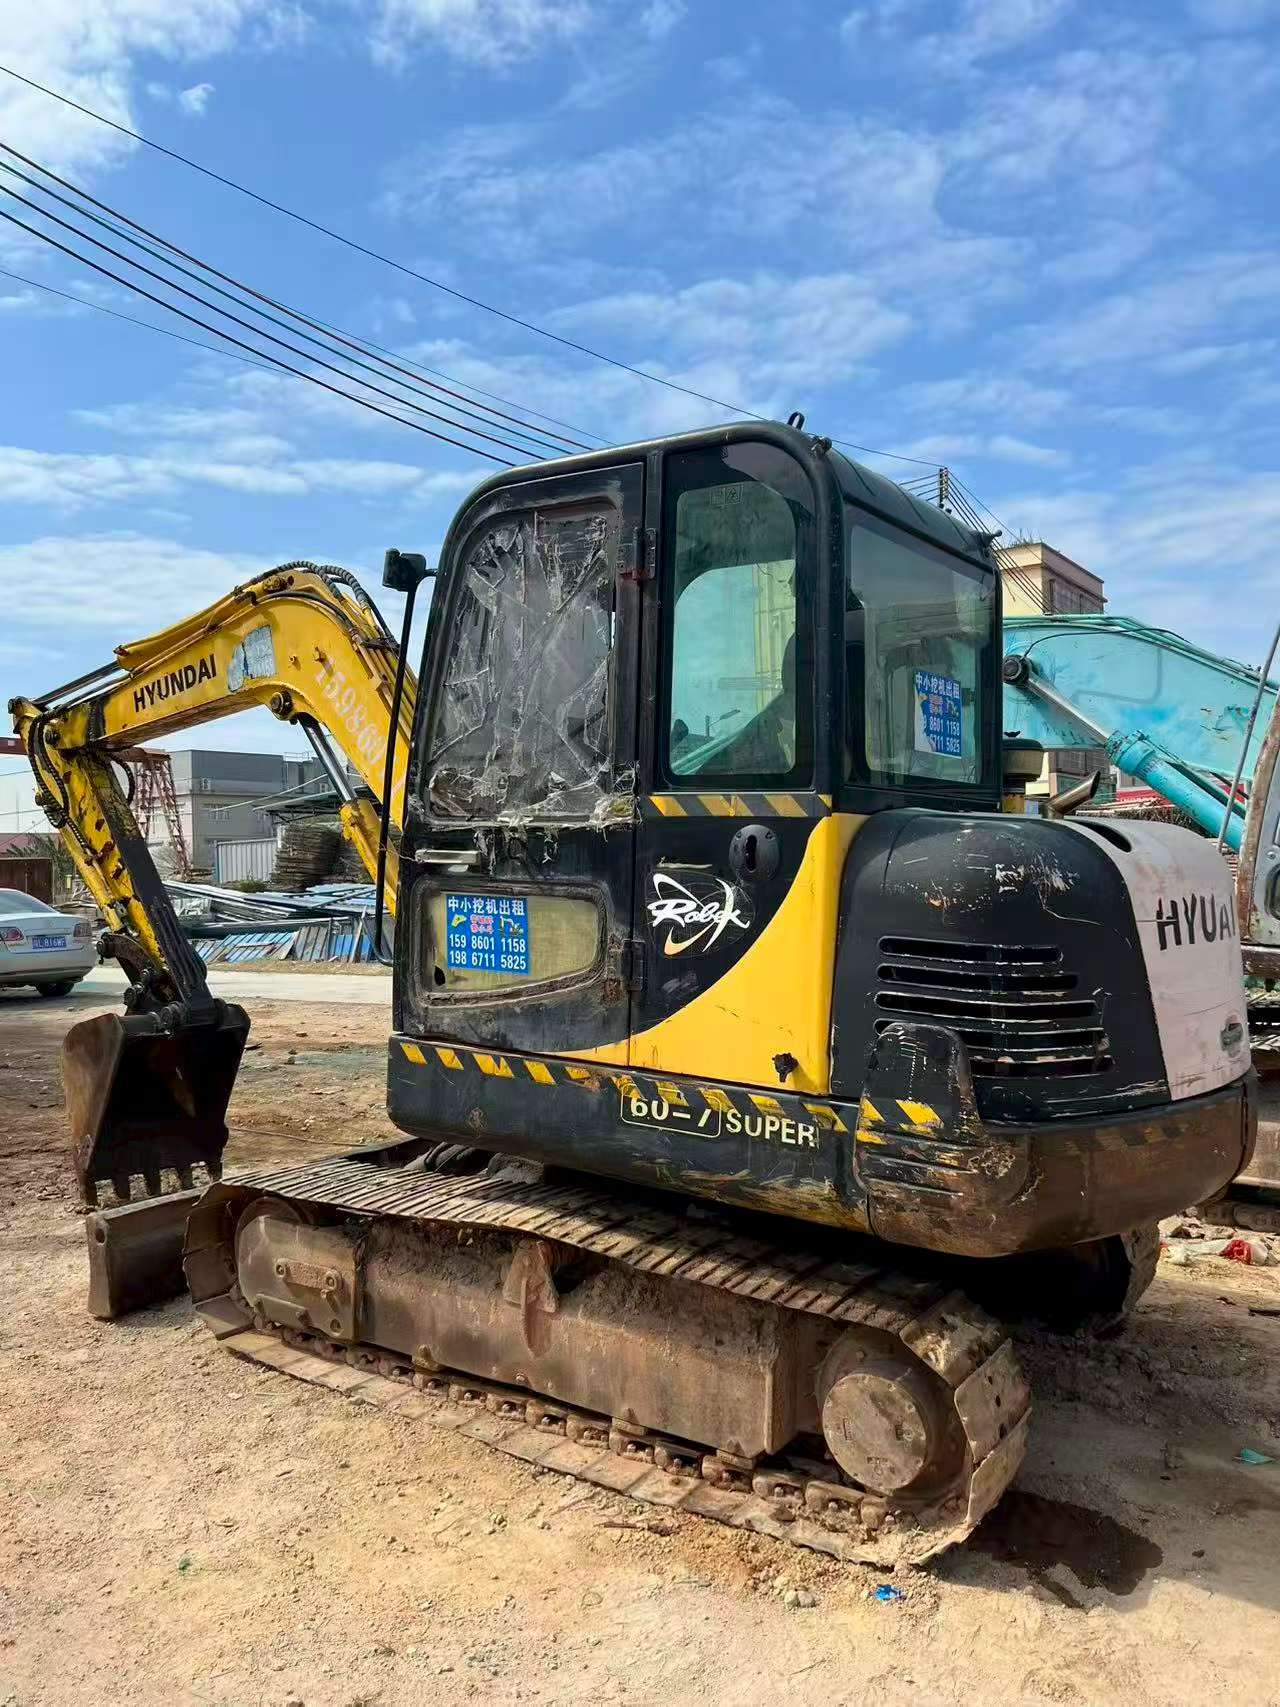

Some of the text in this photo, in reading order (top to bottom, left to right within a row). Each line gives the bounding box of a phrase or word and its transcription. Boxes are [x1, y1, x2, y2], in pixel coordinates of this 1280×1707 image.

[133, 654, 217, 712] HYUNDAI
[448, 896, 525, 916] 中小挖机出租
[449, 934, 526, 953] 159 8601 1158
[449, 950, 526, 970] 198 6711 5825
[725, 1108, 815, 1147] SUPER
